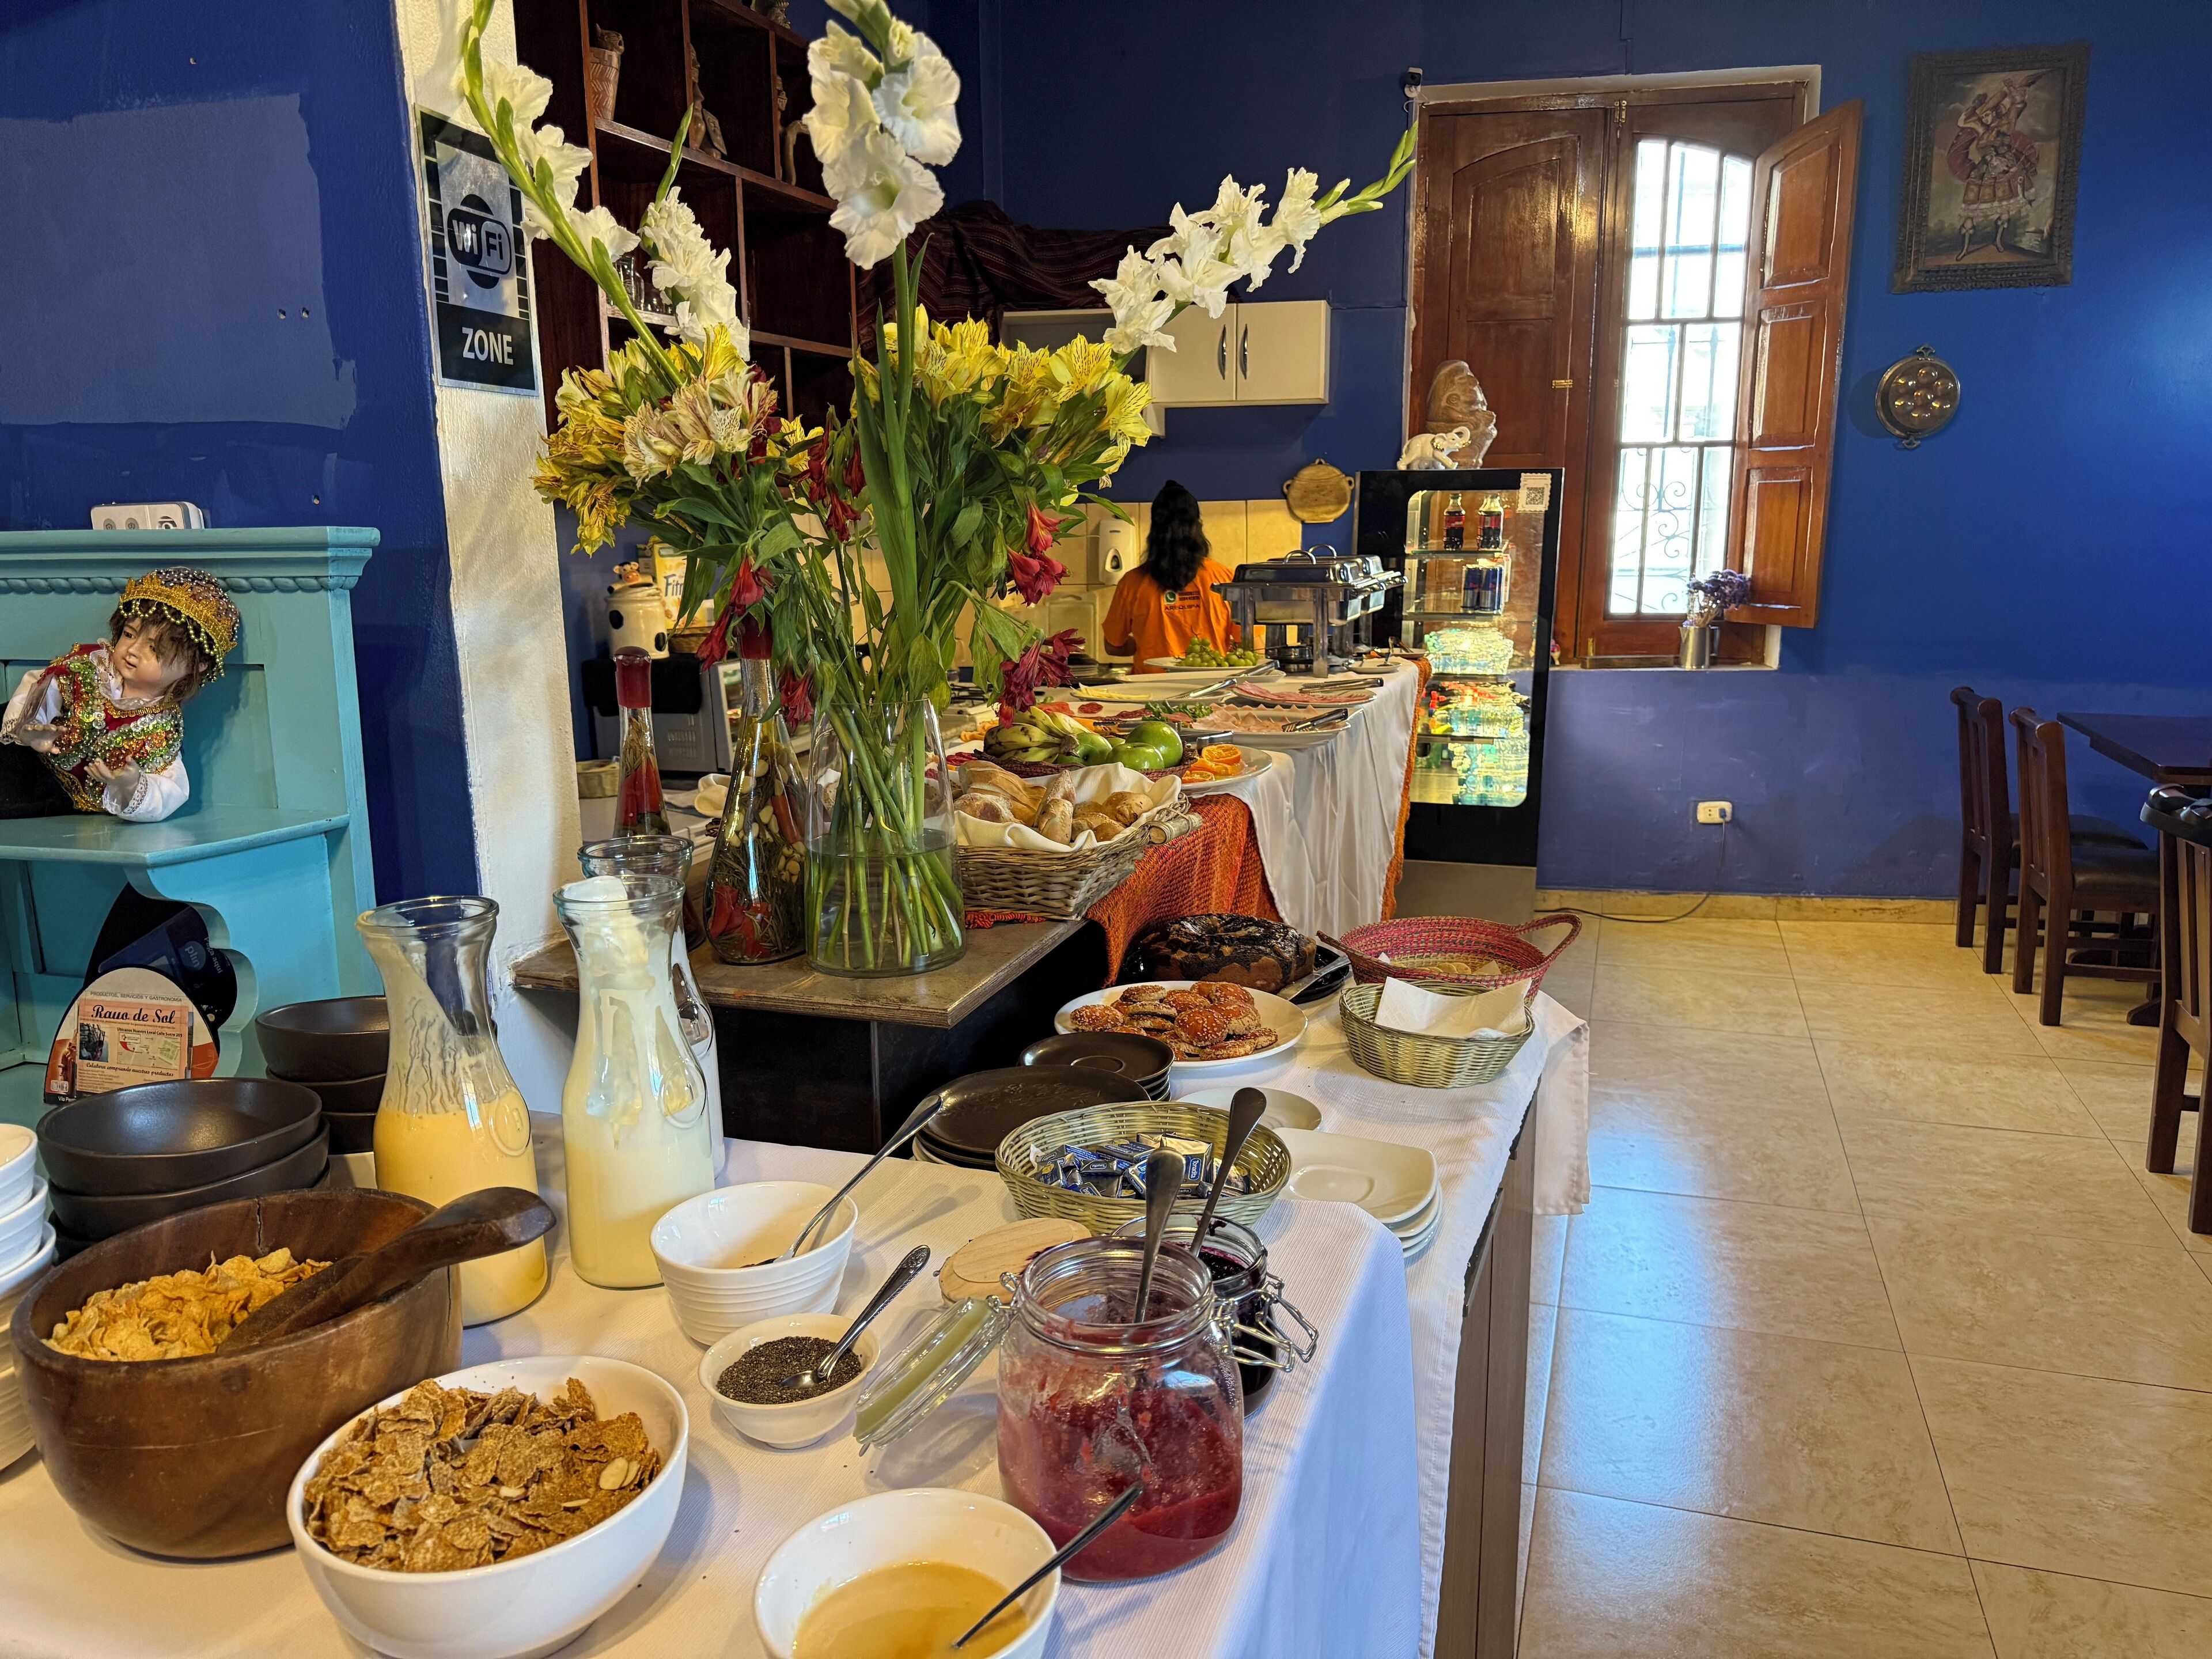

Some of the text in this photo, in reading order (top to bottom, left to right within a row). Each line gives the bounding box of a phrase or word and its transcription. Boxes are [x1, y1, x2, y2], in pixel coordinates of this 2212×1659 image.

[462, 327, 514, 365] ZONE
[133, 1007, 149, 1022] de
[152, 1009, 176, 1024] Sol
